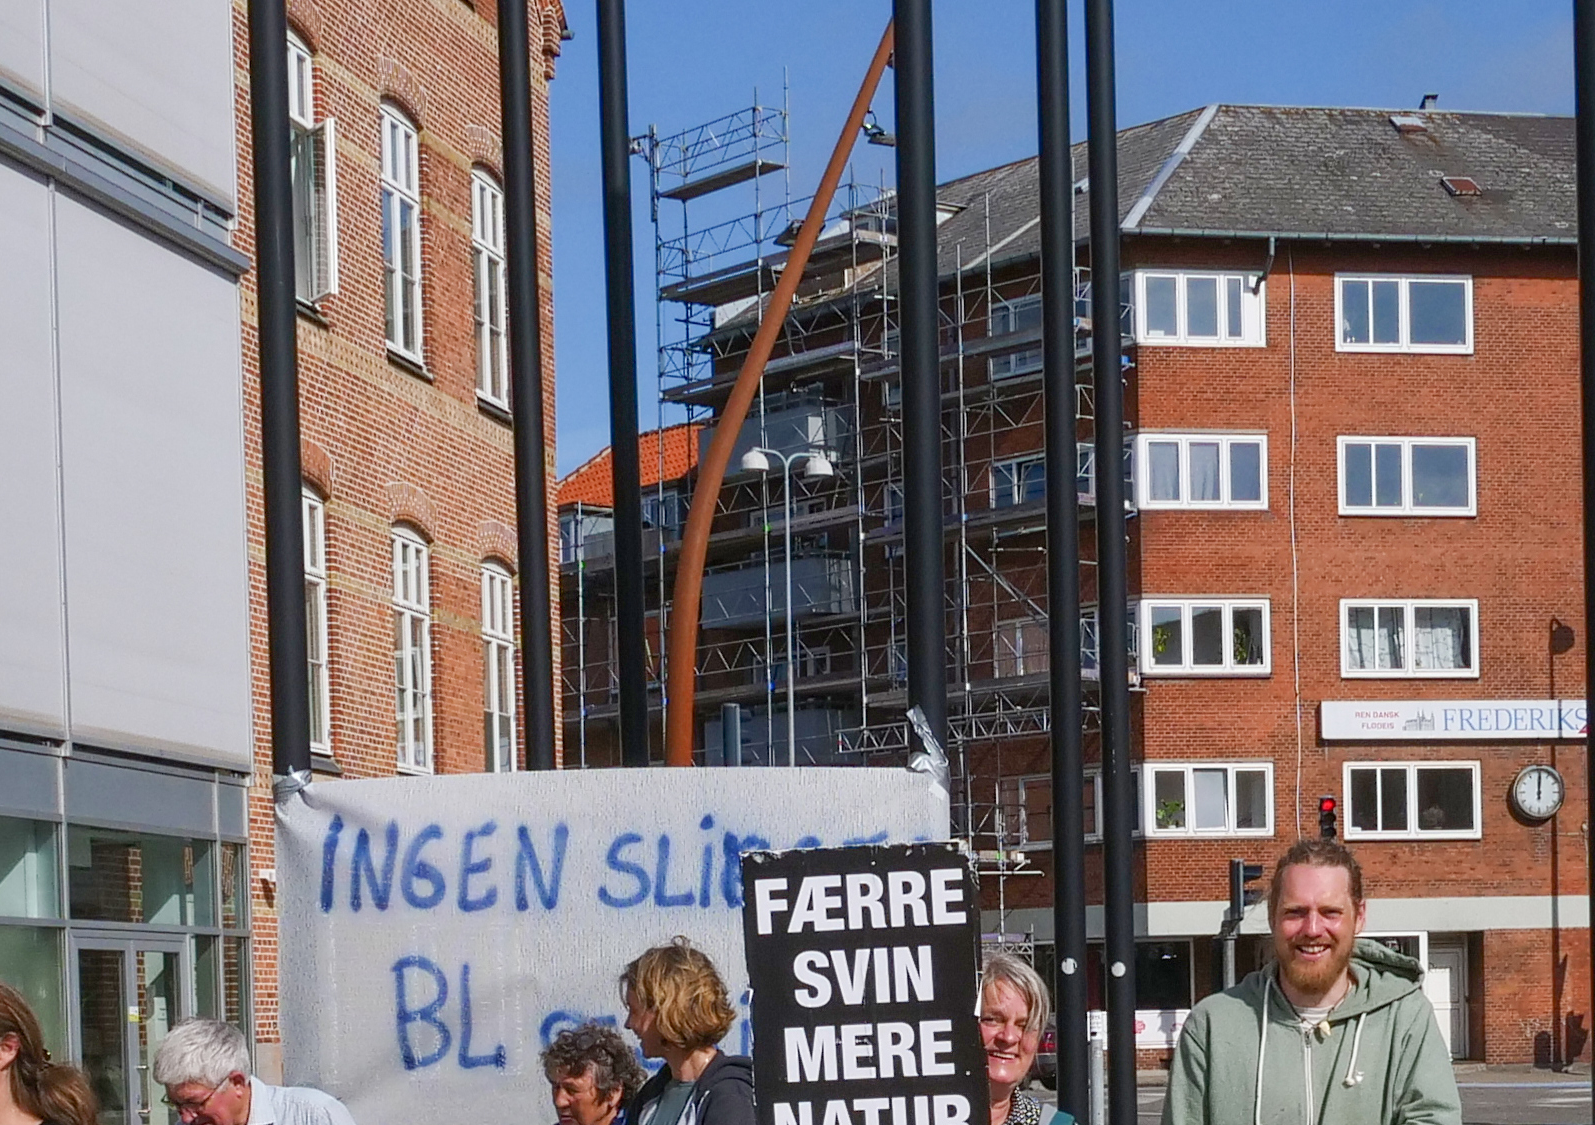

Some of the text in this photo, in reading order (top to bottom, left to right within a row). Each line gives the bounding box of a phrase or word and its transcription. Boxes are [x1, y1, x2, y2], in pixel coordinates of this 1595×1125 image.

[1354, 711, 1400, 719] REN DANSK
[319, 812, 569, 914] INGEN
[754, 867, 968, 936] FÆRRE
[793, 945, 934, 1009] SVIN
[784, 1019, 956, 1083] MERE
